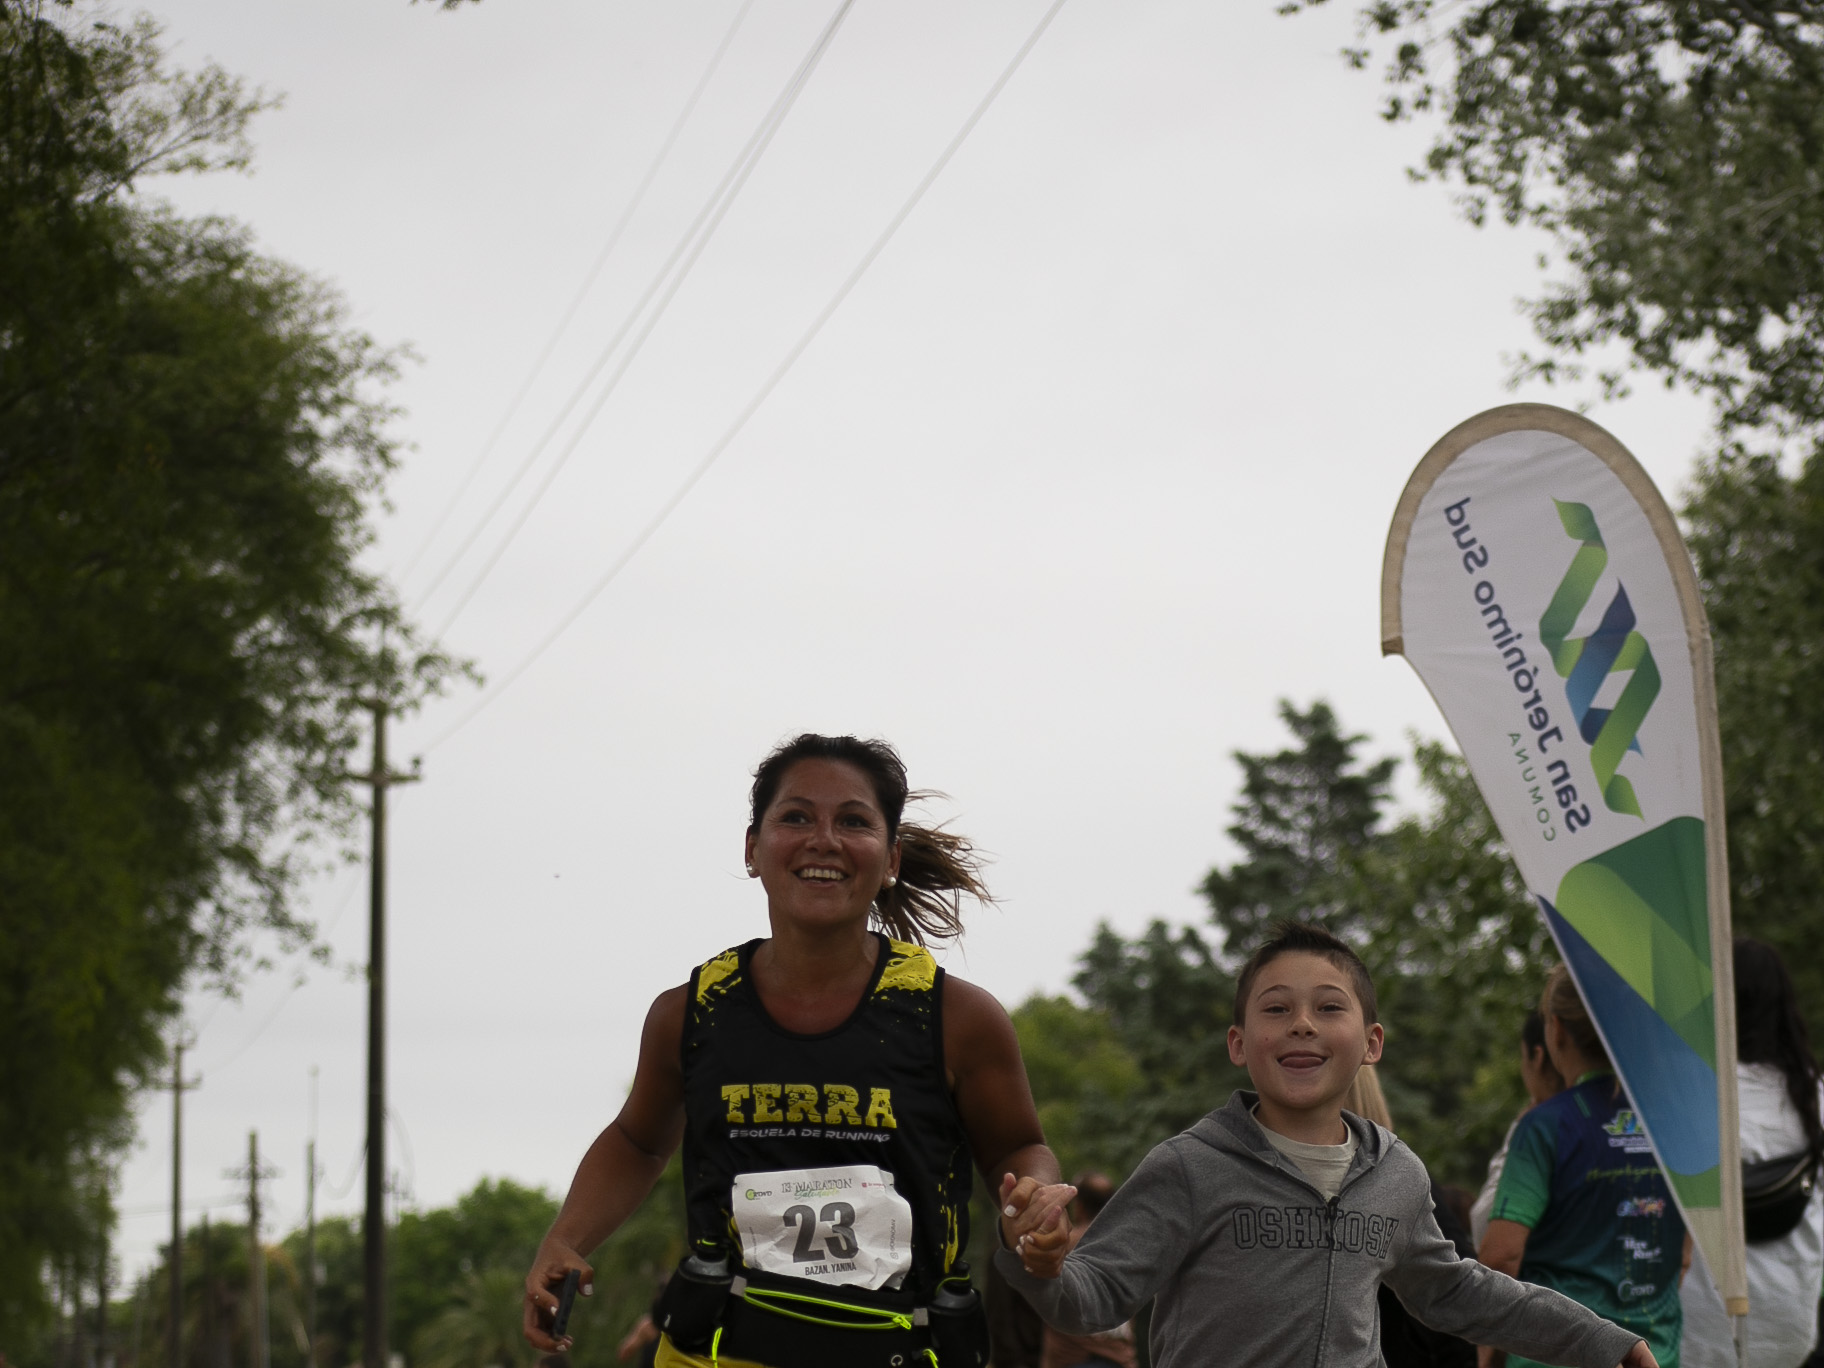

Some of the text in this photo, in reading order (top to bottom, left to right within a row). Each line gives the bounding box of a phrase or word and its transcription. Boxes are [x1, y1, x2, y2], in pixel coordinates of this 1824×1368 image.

[721, 1083, 898, 1128] TERRA
[729, 1128, 892, 1142] ESCUELA DE RUNNING
[782, 1201, 860, 1264] 23
[1232, 1206, 1400, 1260] OSHKOSH
[831, 1261, 857, 1273] YANINA
